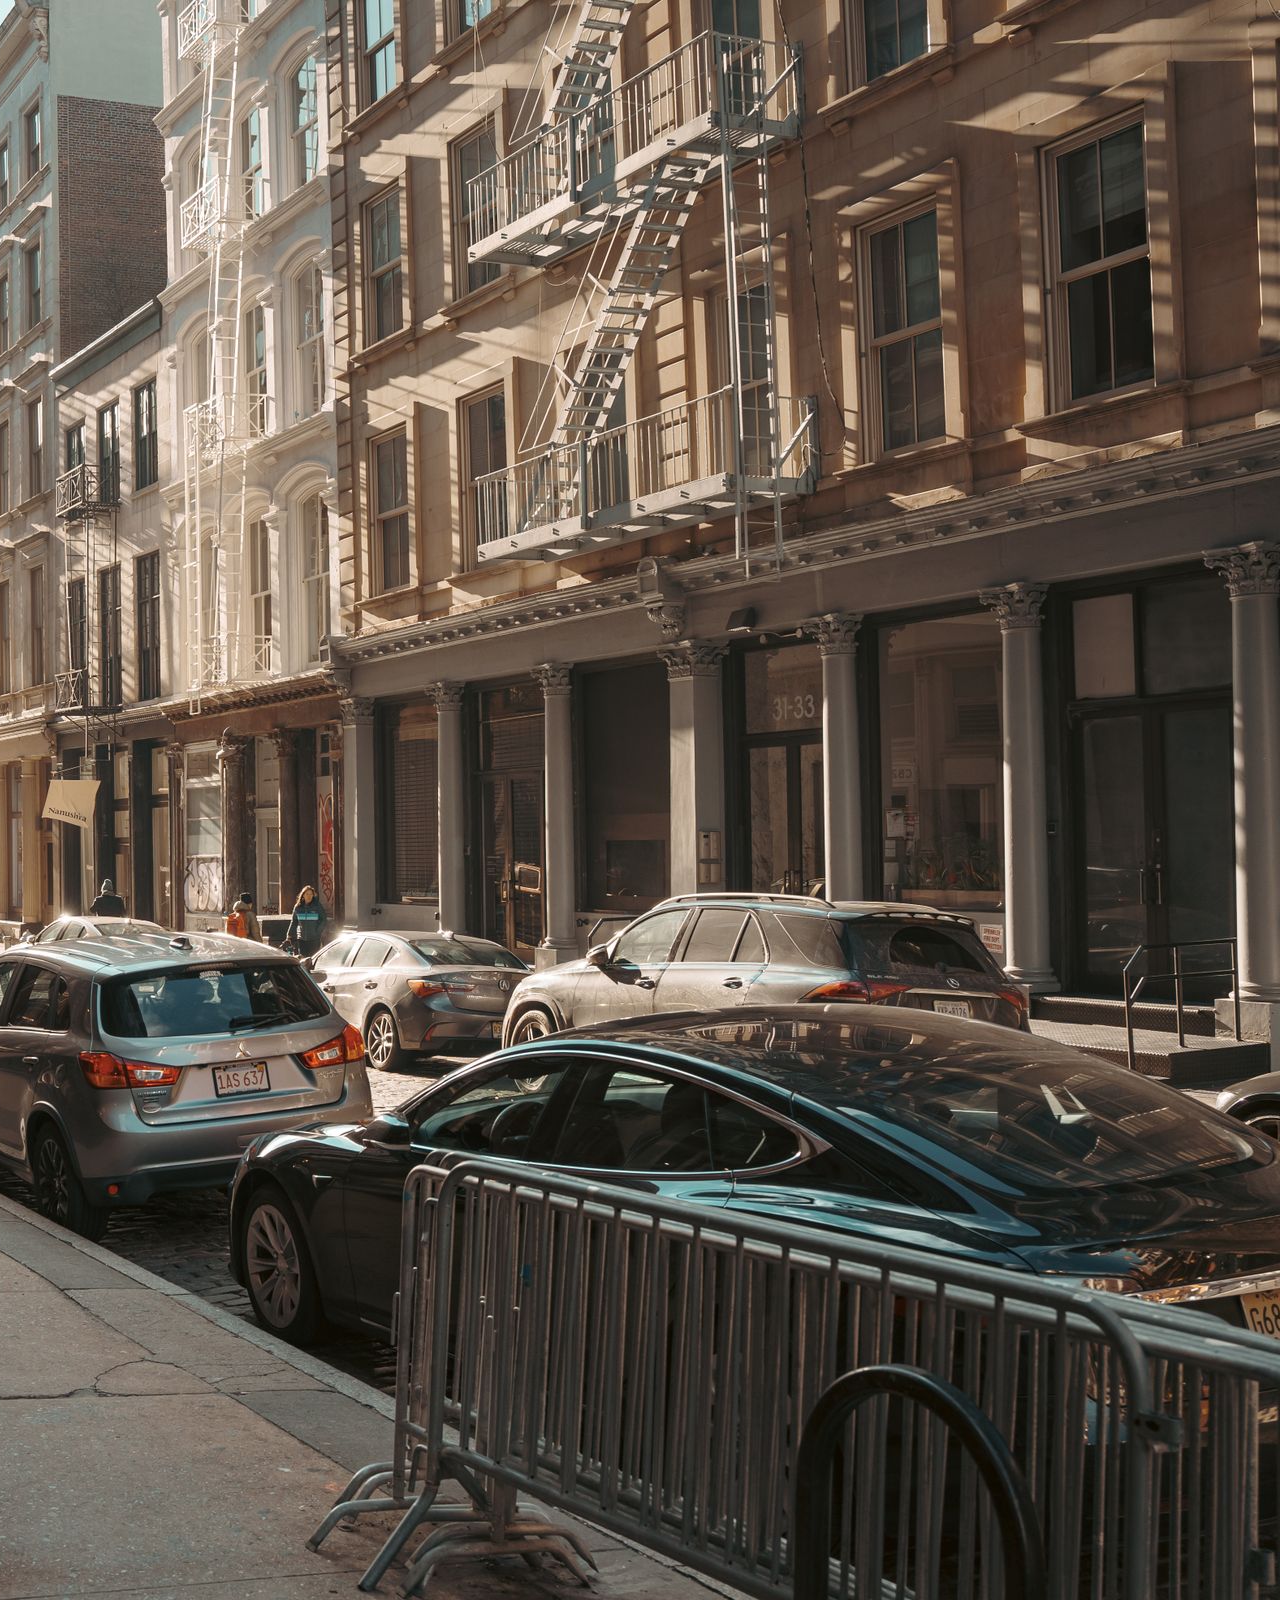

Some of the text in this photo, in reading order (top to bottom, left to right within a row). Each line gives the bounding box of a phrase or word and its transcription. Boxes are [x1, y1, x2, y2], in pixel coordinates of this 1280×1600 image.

[772, 694, 815, 720] 31-33
[217, 1069, 265, 1090] 1AS 637
